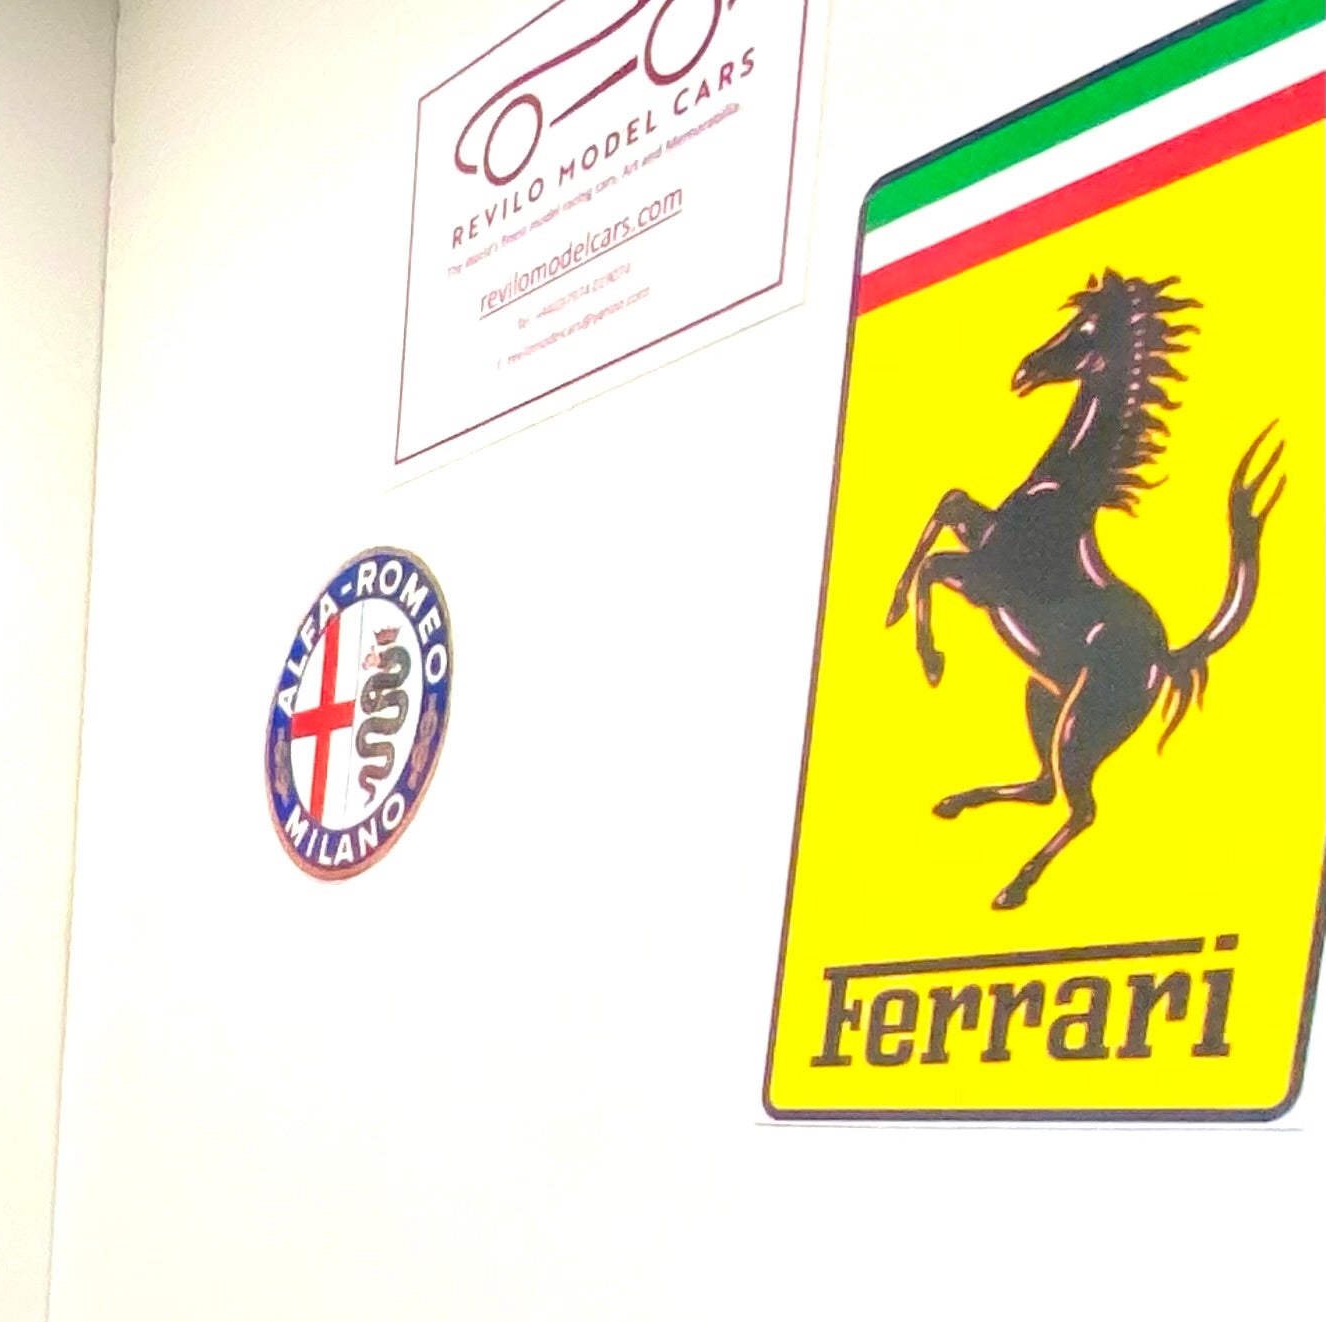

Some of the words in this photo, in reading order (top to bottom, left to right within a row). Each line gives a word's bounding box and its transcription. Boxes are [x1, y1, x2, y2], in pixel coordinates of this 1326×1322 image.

[451, 177, 545, 250] REVILO
[558, 109, 658, 187] MODEL
[673, 47, 756, 116] CARS
[479, 188, 684, 313] revilomodelcars.com
[278, 560, 448, 718] ALFA-ROMEO
[284, 792, 406, 866] MILANO
[810, 933, 1240, 1067] Ferrari
